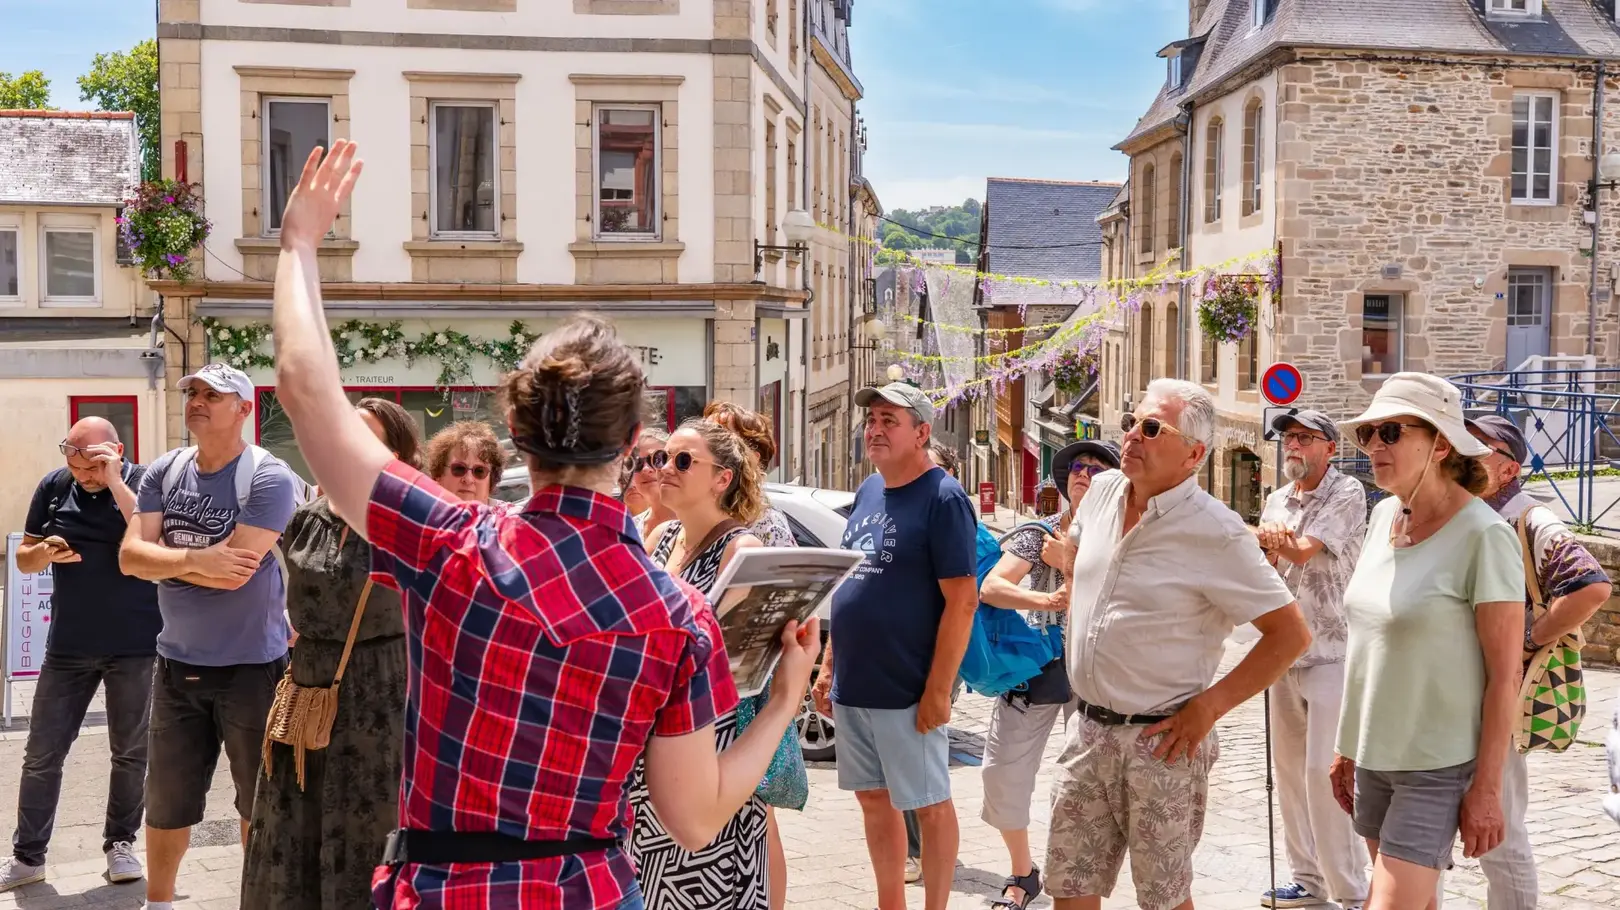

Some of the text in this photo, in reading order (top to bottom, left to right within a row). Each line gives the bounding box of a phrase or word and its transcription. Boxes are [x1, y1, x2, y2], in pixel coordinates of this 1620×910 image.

[355, 375, 394, 384] TRAITEUR
[174, 533, 193, 542] DENIM
[194, 536, 210, 544] WEAR
[859, 566, 884, 574] COMPANY
